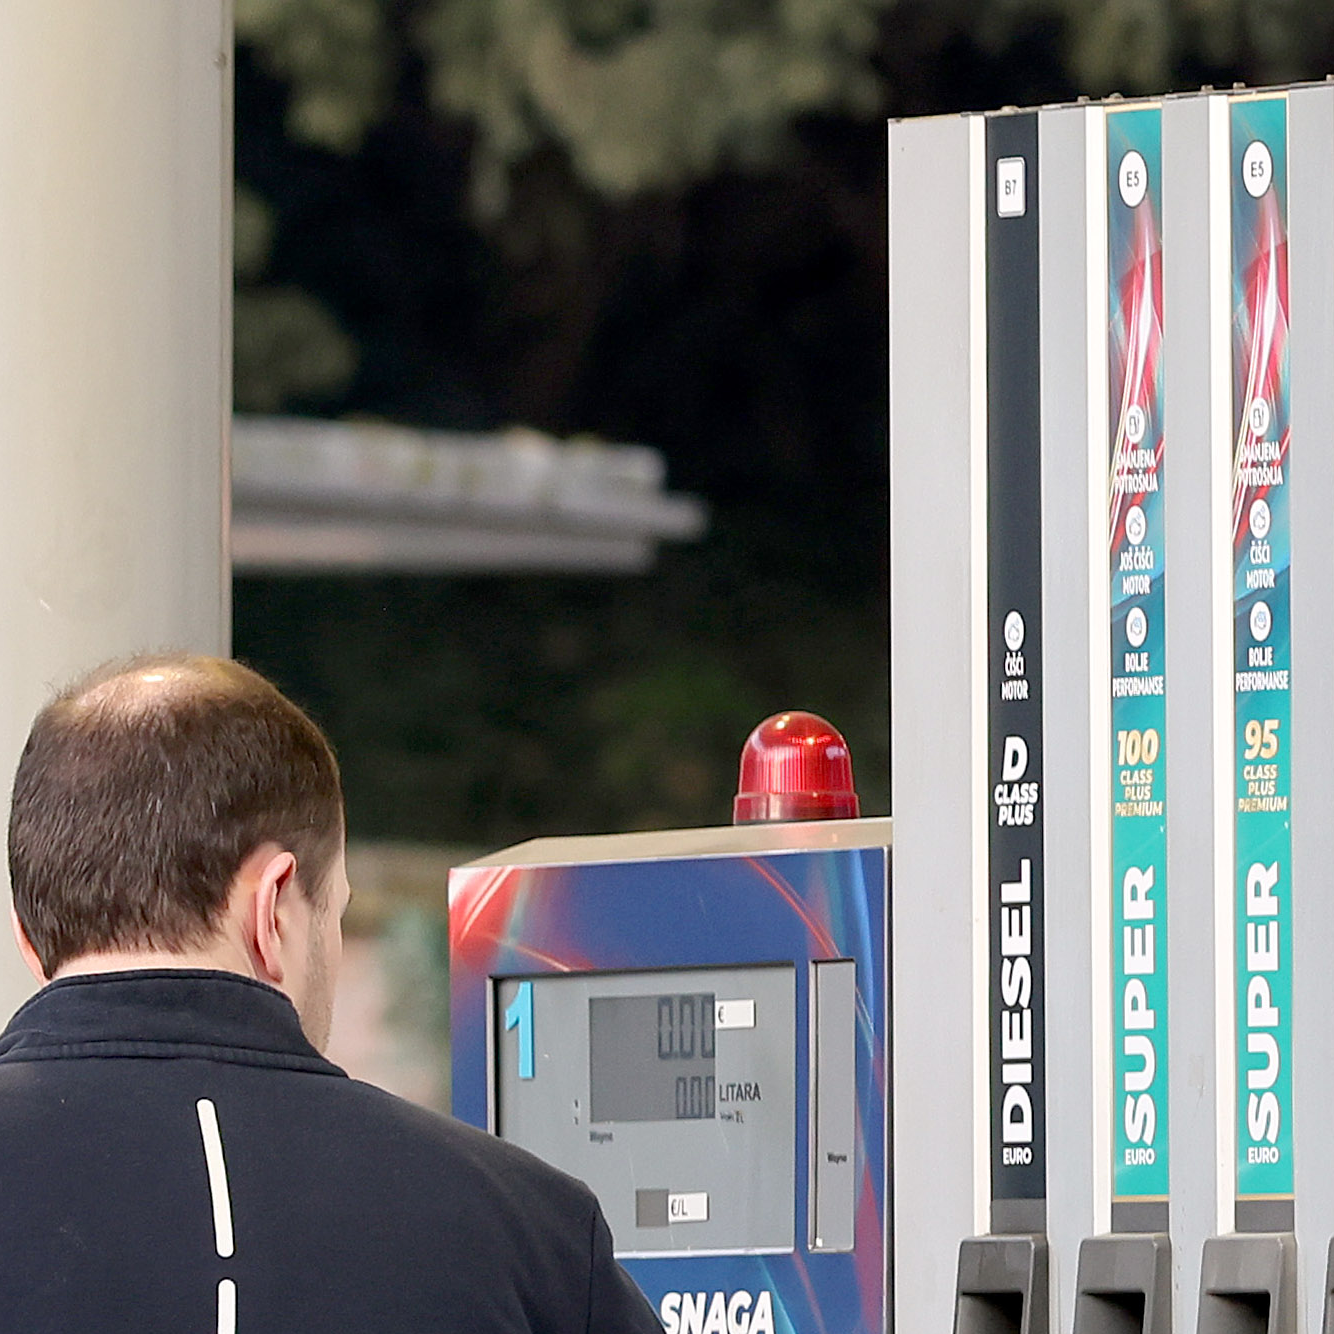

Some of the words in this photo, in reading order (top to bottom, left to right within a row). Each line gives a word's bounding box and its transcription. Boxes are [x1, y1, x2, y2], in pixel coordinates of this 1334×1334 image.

[1251, 162, 1264, 178] E5
[1005, 180, 1017, 195] B7
[1127, 172, 1139, 188] E5
[1117, 449, 1156, 468] SMANJENA
[1241, 442, 1281, 462] SMANJENA
[1119, 547, 1133, 571] JOŠ
[1123, 575, 1151, 594] MOTOR
[1247, 569, 1275, 588] MOTOR
[1125, 653, 1149, 672] BOLJE
[1249, 647, 1273, 666] BOLJE
[1001, 680, 1029, 700] MOTOR
[1113, 676, 1163, 698] PERFORMANSE
[1235, 670, 1289, 692] PERFORMANSE
[1117, 728, 1159, 766] 100
[1244, 719, 1280, 760] 95
[1002, 736, 1027, 781] D
[1120, 768, 1153, 786] CLASS
[1243, 764, 1277, 782] CLASS
[994, 783, 1038, 804] CLASS
[1124, 785, 1151, 801] PLUS
[1247, 780, 1275, 796] PLUS
[1115, 800, 1163, 817] PREMIUM
[1238, 796, 1287, 812] PREMIUM
[998, 804, 1033, 826] PLUS
[1001, 858, 1033, 1144] DIESEL
[1123, 865, 1156, 1145] SUPER
[1246, 860, 1279, 1144] SUPER
[719, 1006, 724, 1023] €
[505, 982, 534, 1080] 1
[719, 1083, 761, 1102] LITARA
[1003, 1146, 1032, 1166] EURO
[1125, 1148, 1155, 1166] EURO
[1247, 1146, 1279, 1165] EURO
[671, 1199, 687, 1216] €/L
